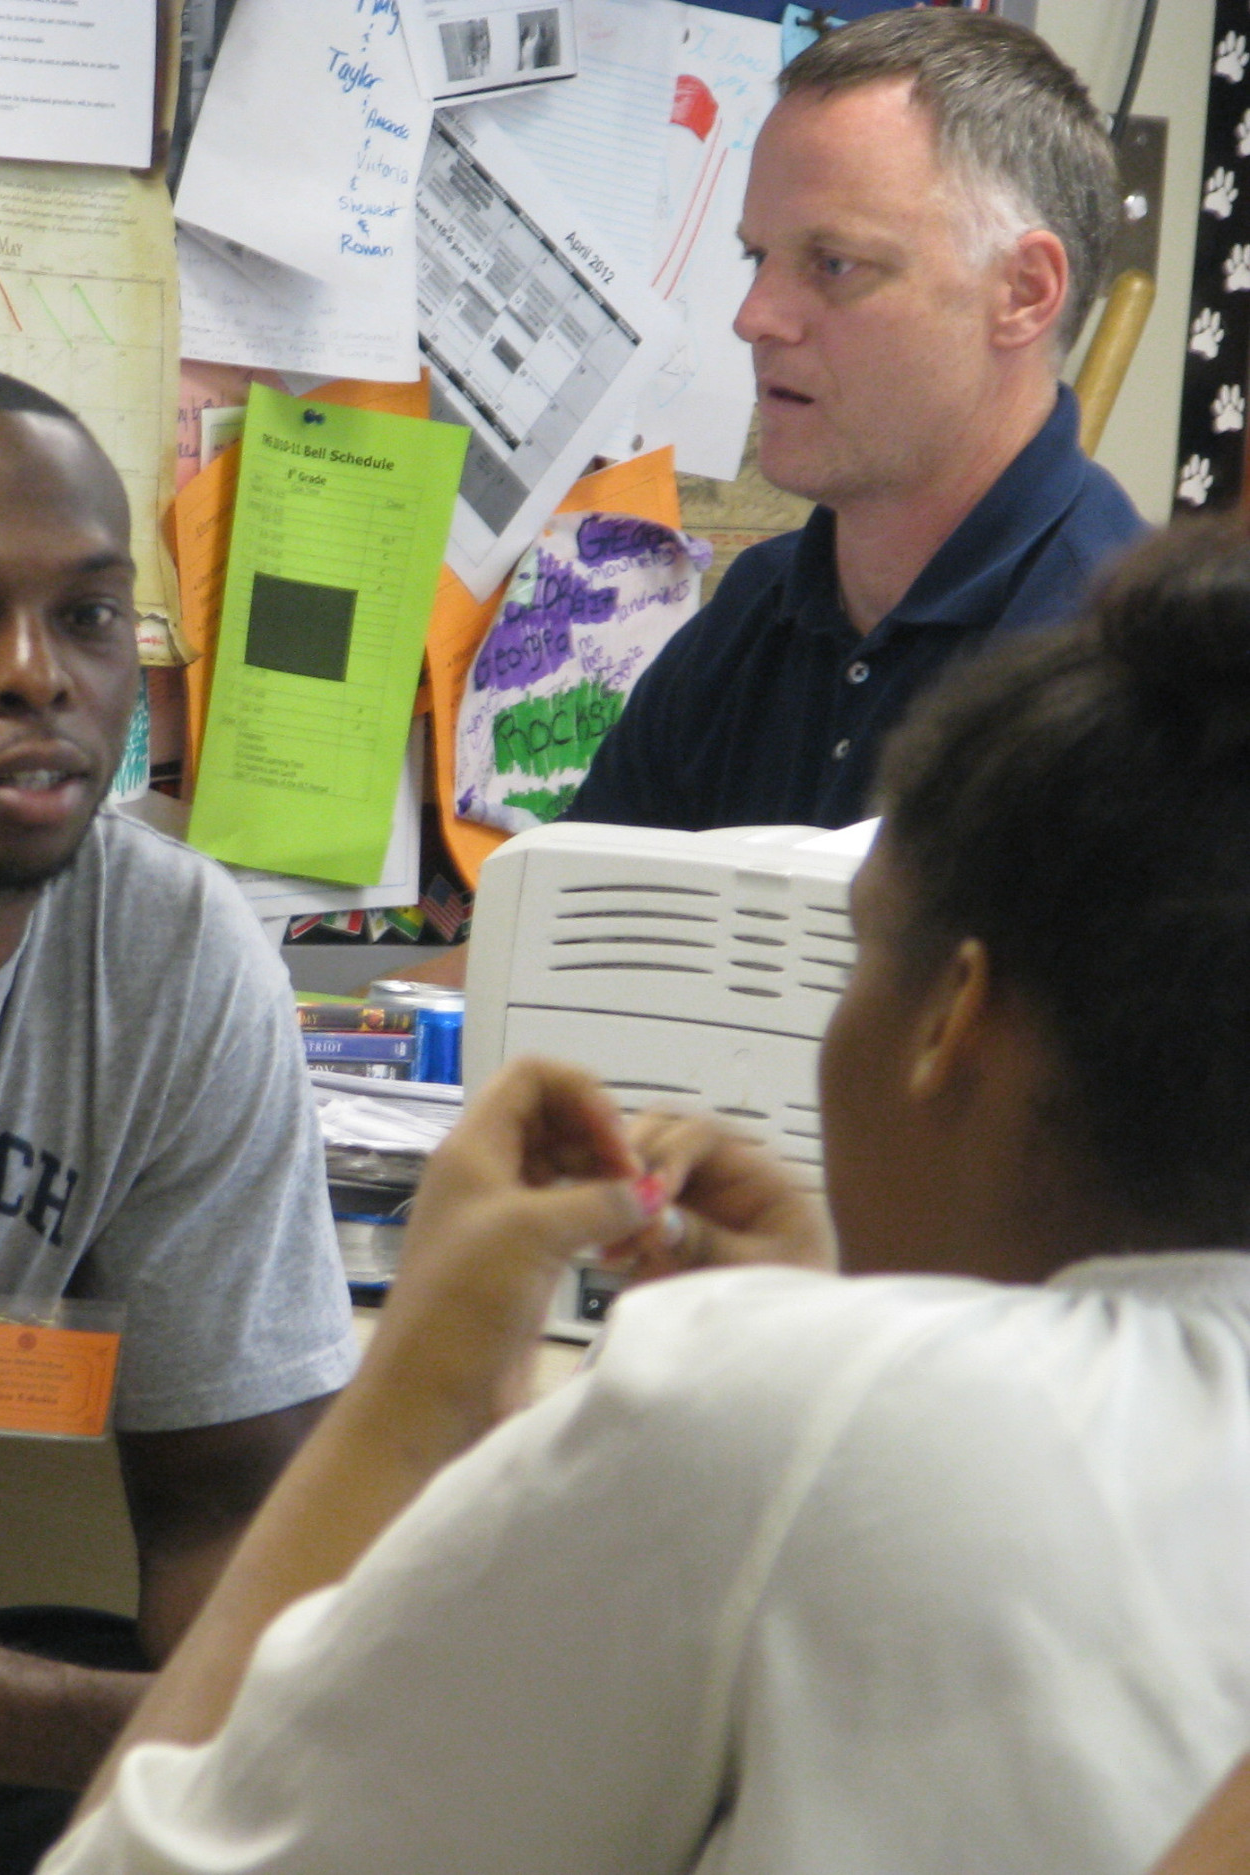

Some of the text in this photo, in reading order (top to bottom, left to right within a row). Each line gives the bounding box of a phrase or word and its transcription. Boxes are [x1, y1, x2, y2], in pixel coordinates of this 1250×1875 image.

[565, 231, 590, 260] April
[588, 255, 617, 285] 2012
[304, 445, 327, 460] Bell
[330, 449, 396, 472] Schedule
[298, 471, 327, 486] Grade
